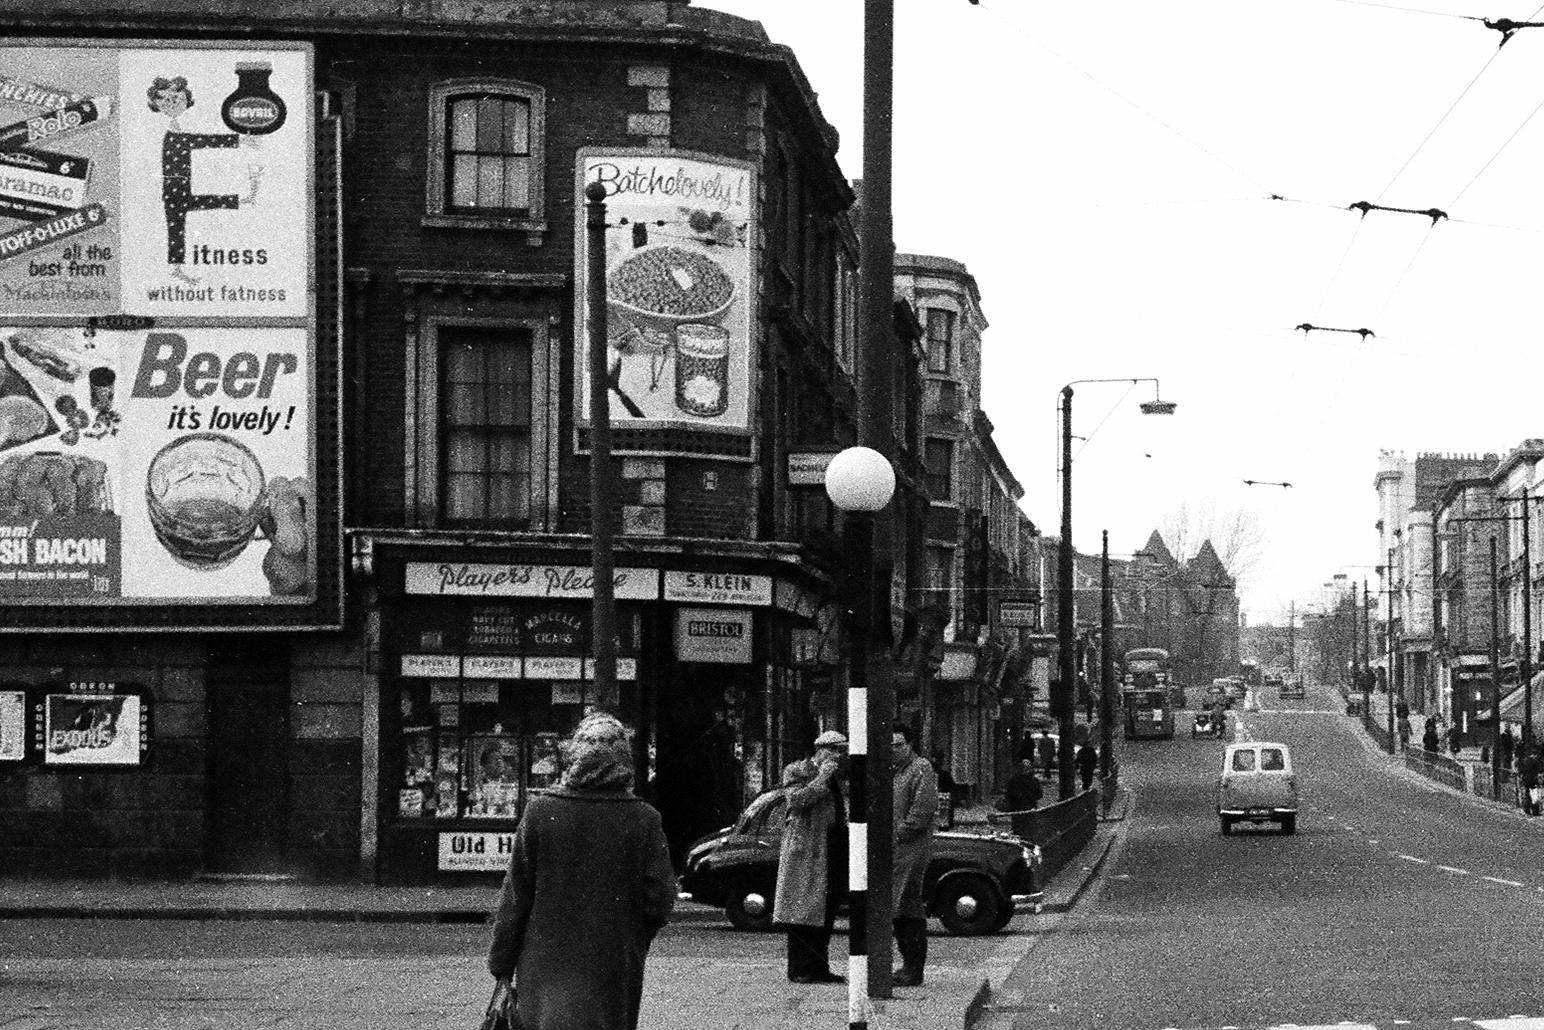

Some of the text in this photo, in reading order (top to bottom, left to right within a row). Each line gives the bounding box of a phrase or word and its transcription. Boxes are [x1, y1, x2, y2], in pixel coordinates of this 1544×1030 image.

[233, 107, 274, 119] BOVRIL
[26, 110, 82, 142] Rolo
[63, 243, 112, 260] all the
[29, 260, 106, 276] best from
[147, 286, 287, 301] without fatness
[131, 332, 298, 400] Beer
[168, 405, 202, 430] it's
[35, 538, 107, 566] BACON
[544, 568, 627, 596] Pleae
[704, 575, 752, 591] KLEIN
[689, 622, 743, 637] BRISTOL
